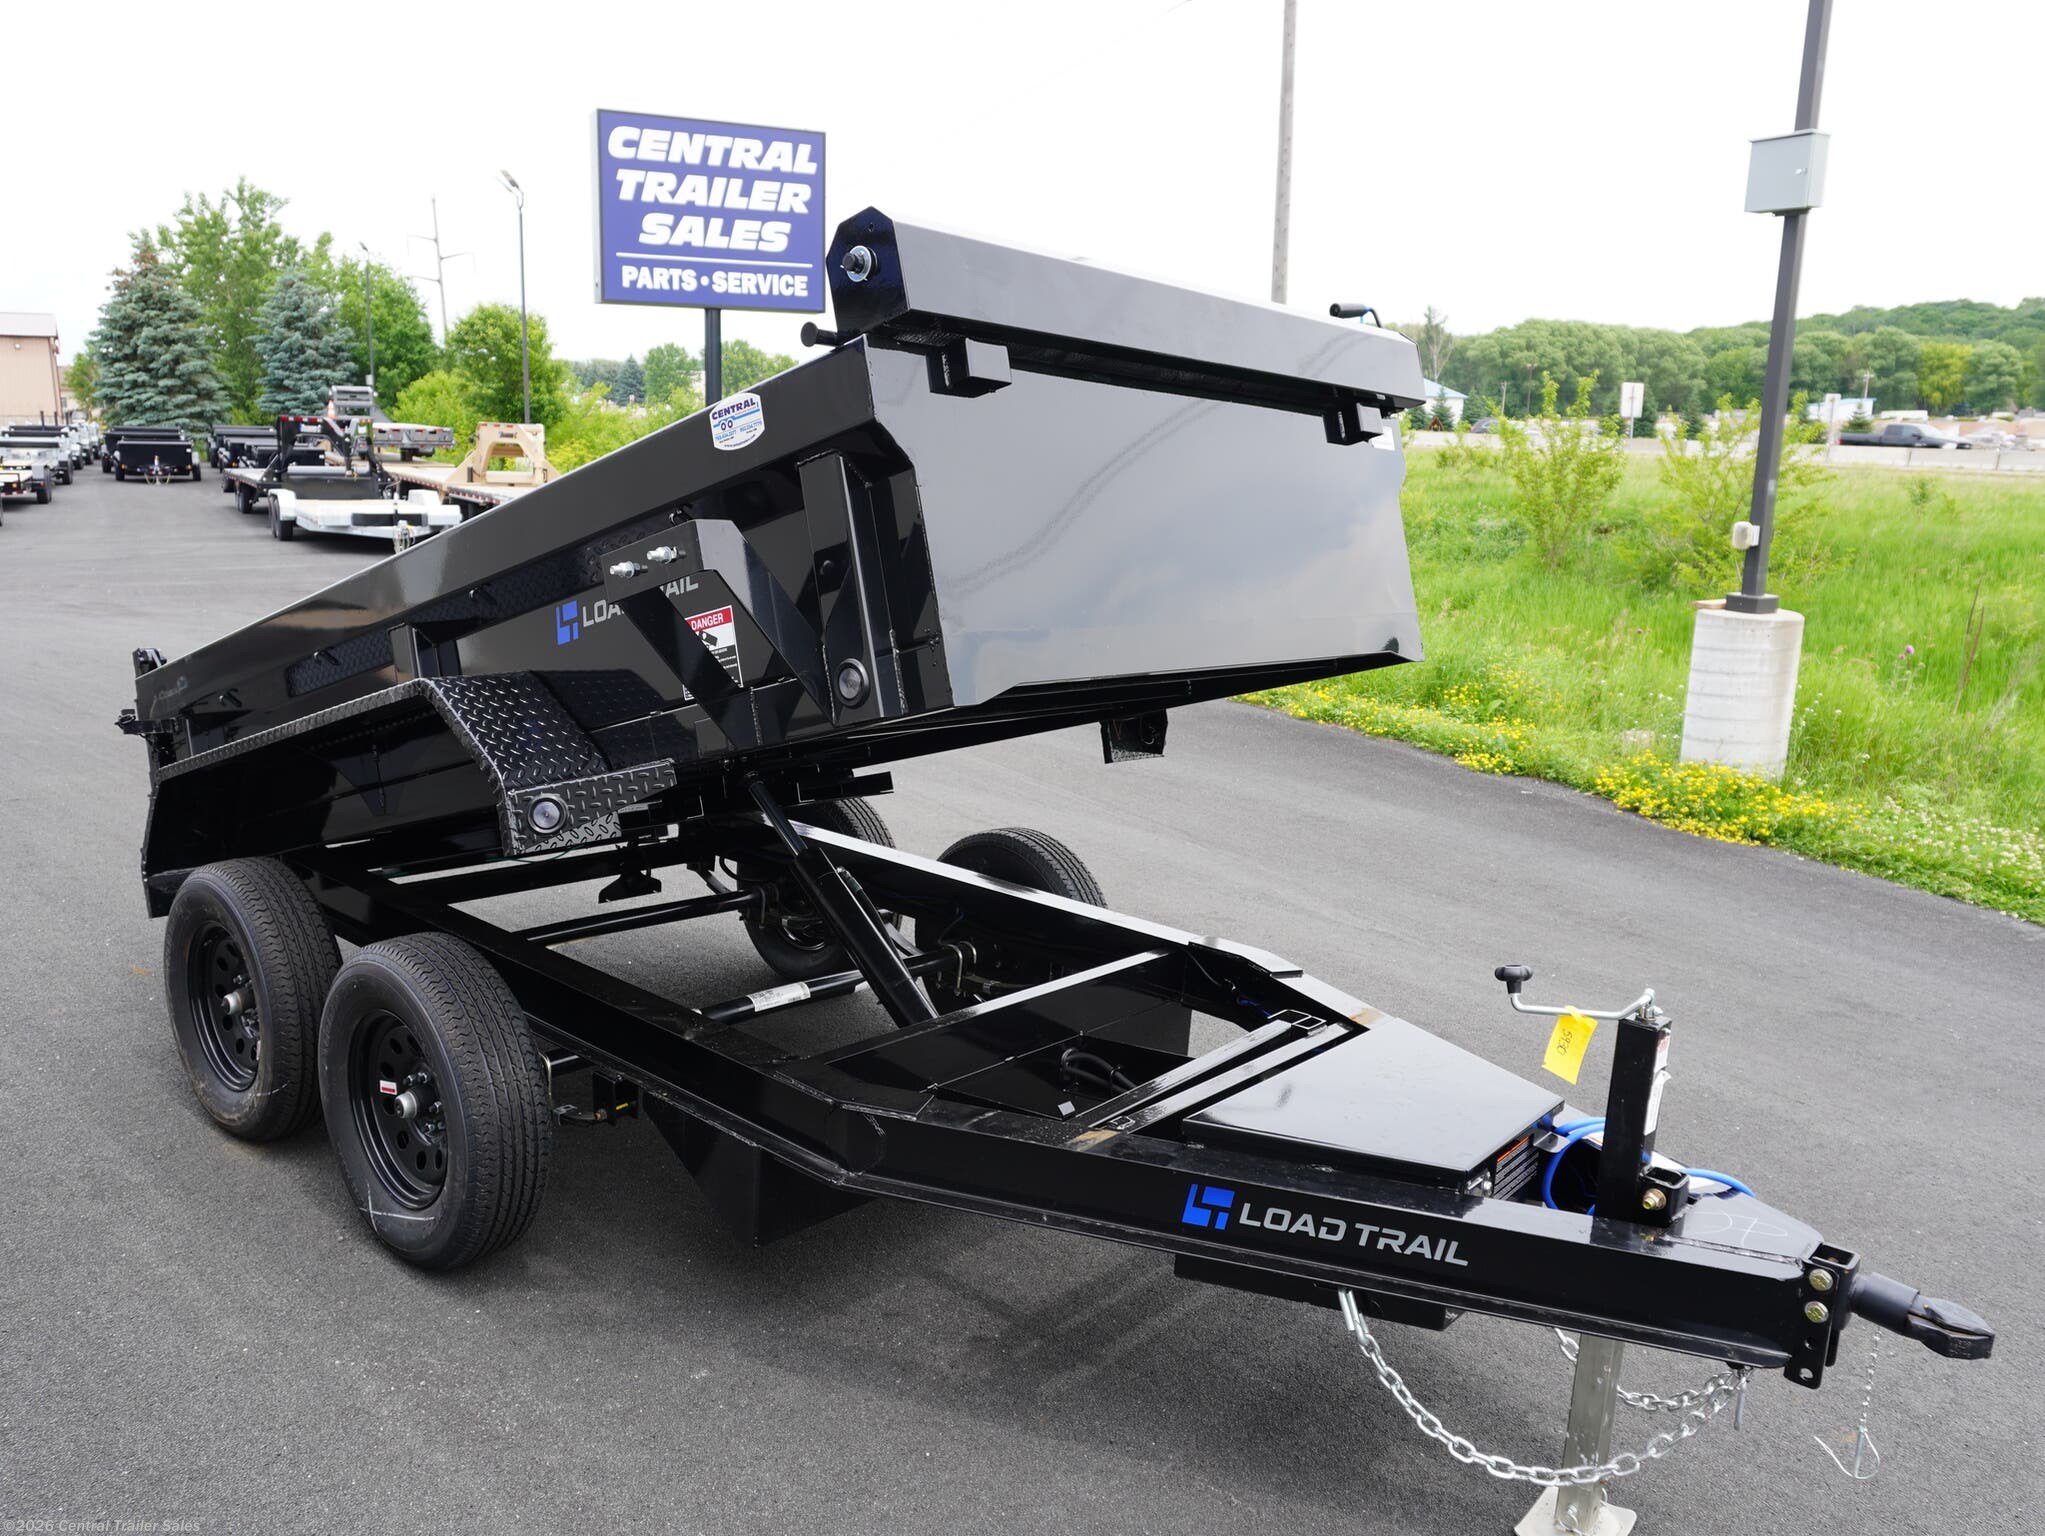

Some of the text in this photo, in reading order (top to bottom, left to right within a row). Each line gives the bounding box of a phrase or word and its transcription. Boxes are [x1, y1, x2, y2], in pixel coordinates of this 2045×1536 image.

[608, 126, 818, 175] CENTRAL
[616, 168, 812, 214] TRAILER
[638, 212, 792, 253] SALES
[711, 398, 756, 420] CENTRAL
[582, 600, 625, 628] LOA
[691, 613, 724, 631] DANGER
[1239, 1203, 1469, 1266] LOAD TRAIL
